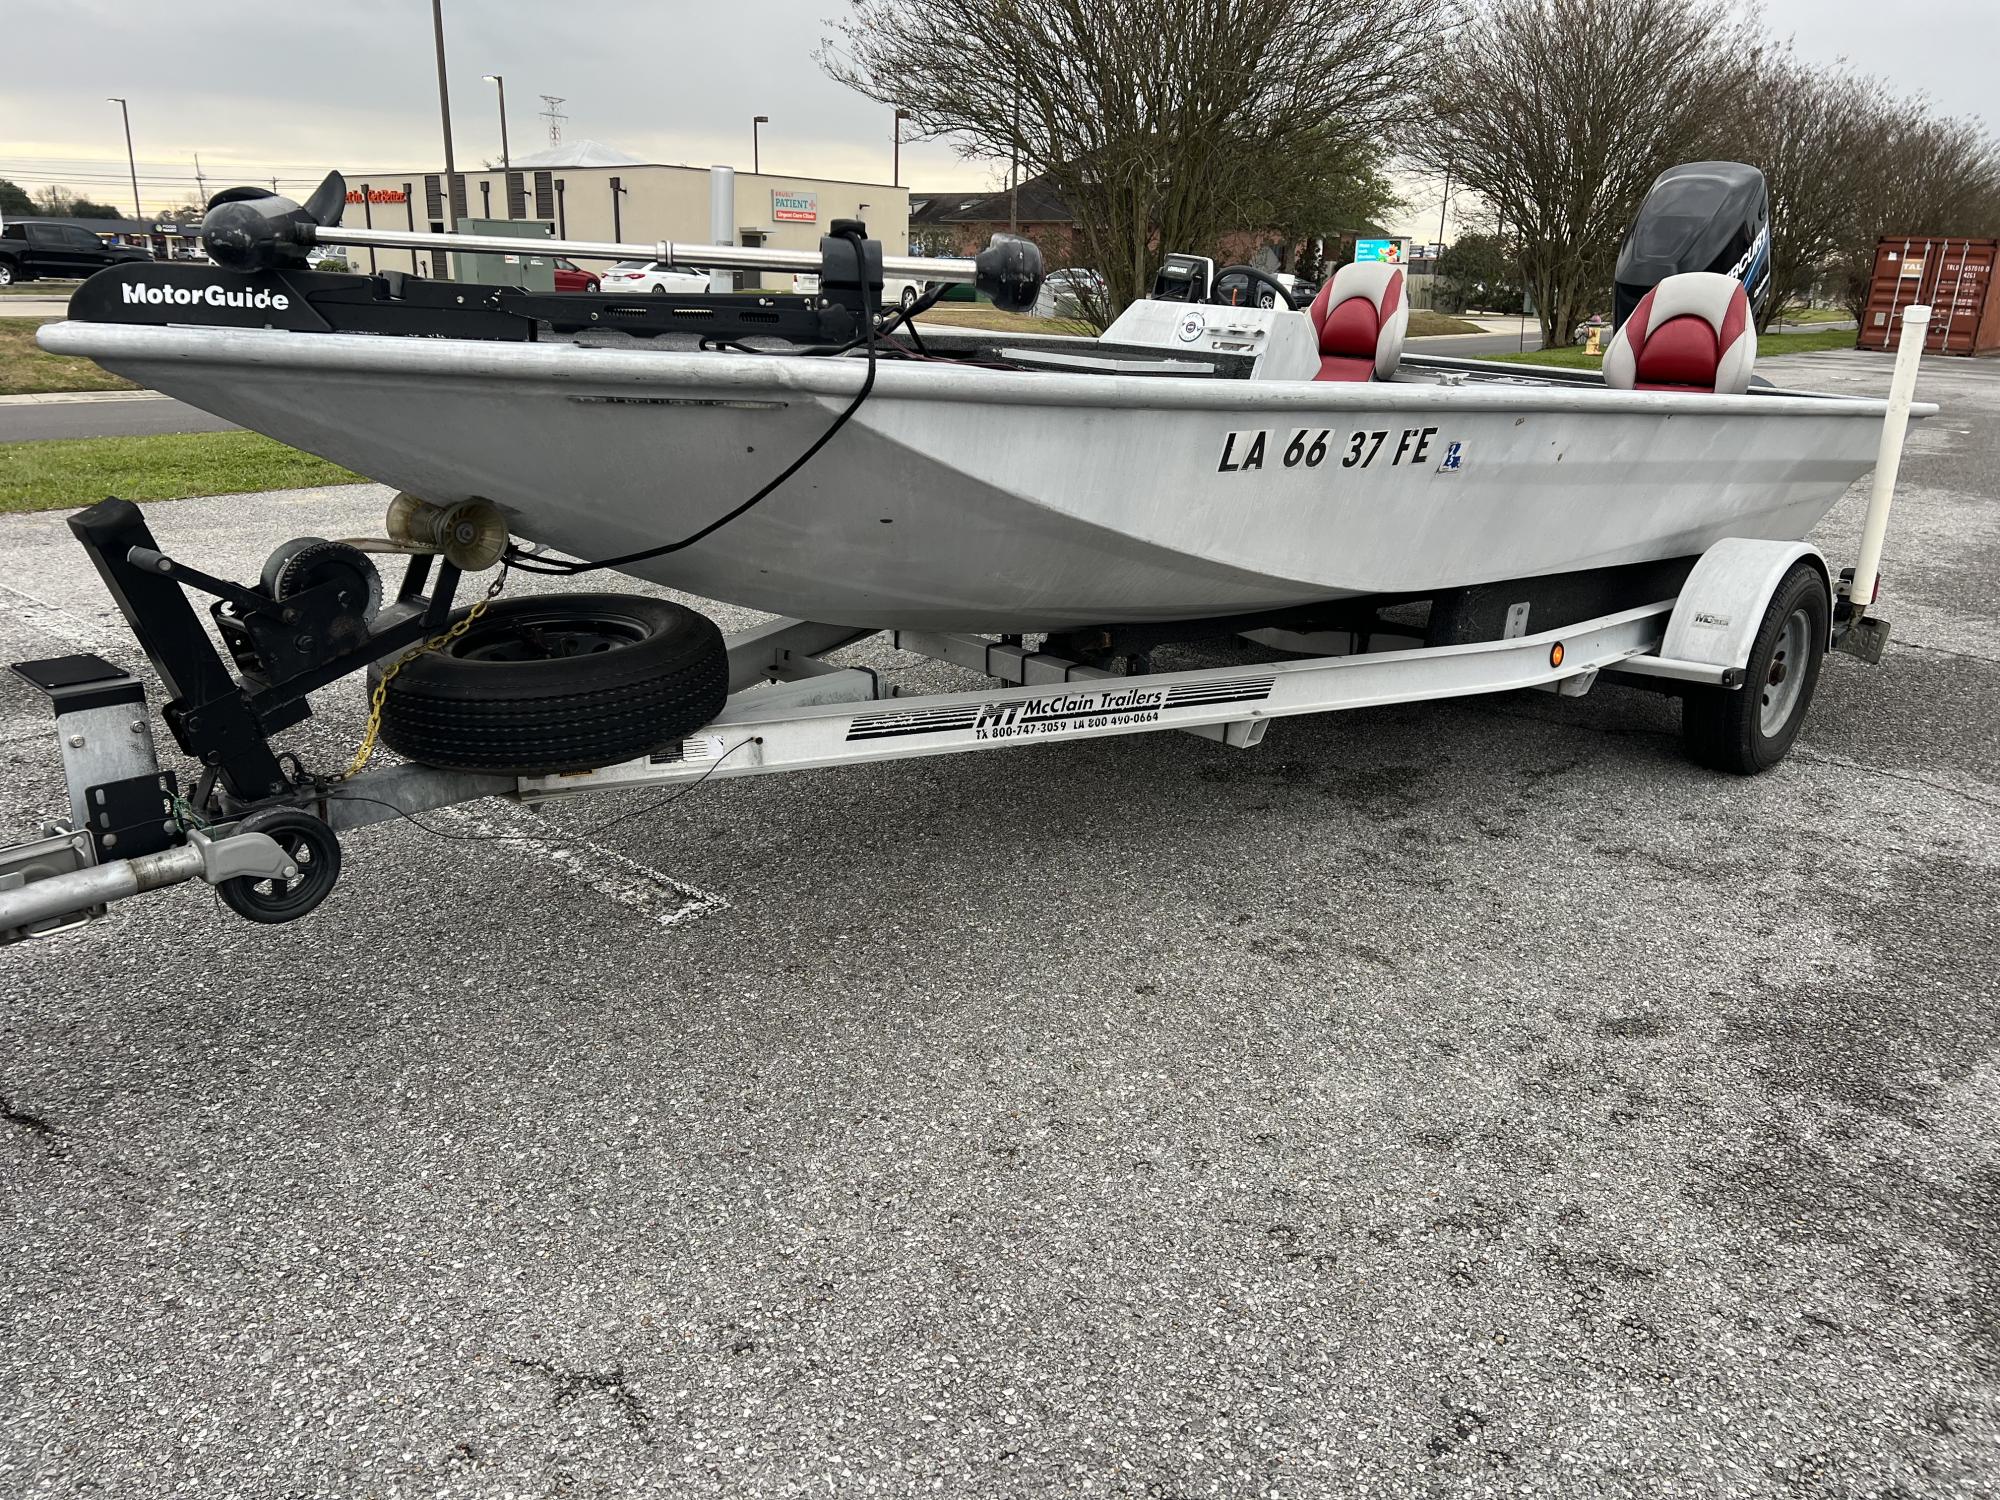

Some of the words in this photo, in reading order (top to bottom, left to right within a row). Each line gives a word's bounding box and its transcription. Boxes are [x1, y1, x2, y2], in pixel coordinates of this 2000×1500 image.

[775, 198, 809, 209] PATIENT
[777, 211, 793, 219] Urgent
[1726, 221, 1770, 280] RCURY
[1167, 265, 1188, 274] LOWRANCE
[1903, 263, 1923, 271] TAL
[121, 282, 289, 310] MotorGuide
[1217, 431, 1267, 472] LA
[1283, 429, 1330, 468] 66
[1342, 431, 1389, 469] 37
[1392, 427, 1438, 466] FE
[1024, 694, 1094, 716] McClain
[1101, 688, 1162, 709] Trailers
[976, 728, 989, 740] TX
[991, 721, 1067, 738] 800-747-3059
[1073, 720, 1085, 730] LA
[1088, 716, 1107, 728] 800
[1110, 711, 1159, 725] 490-0664
